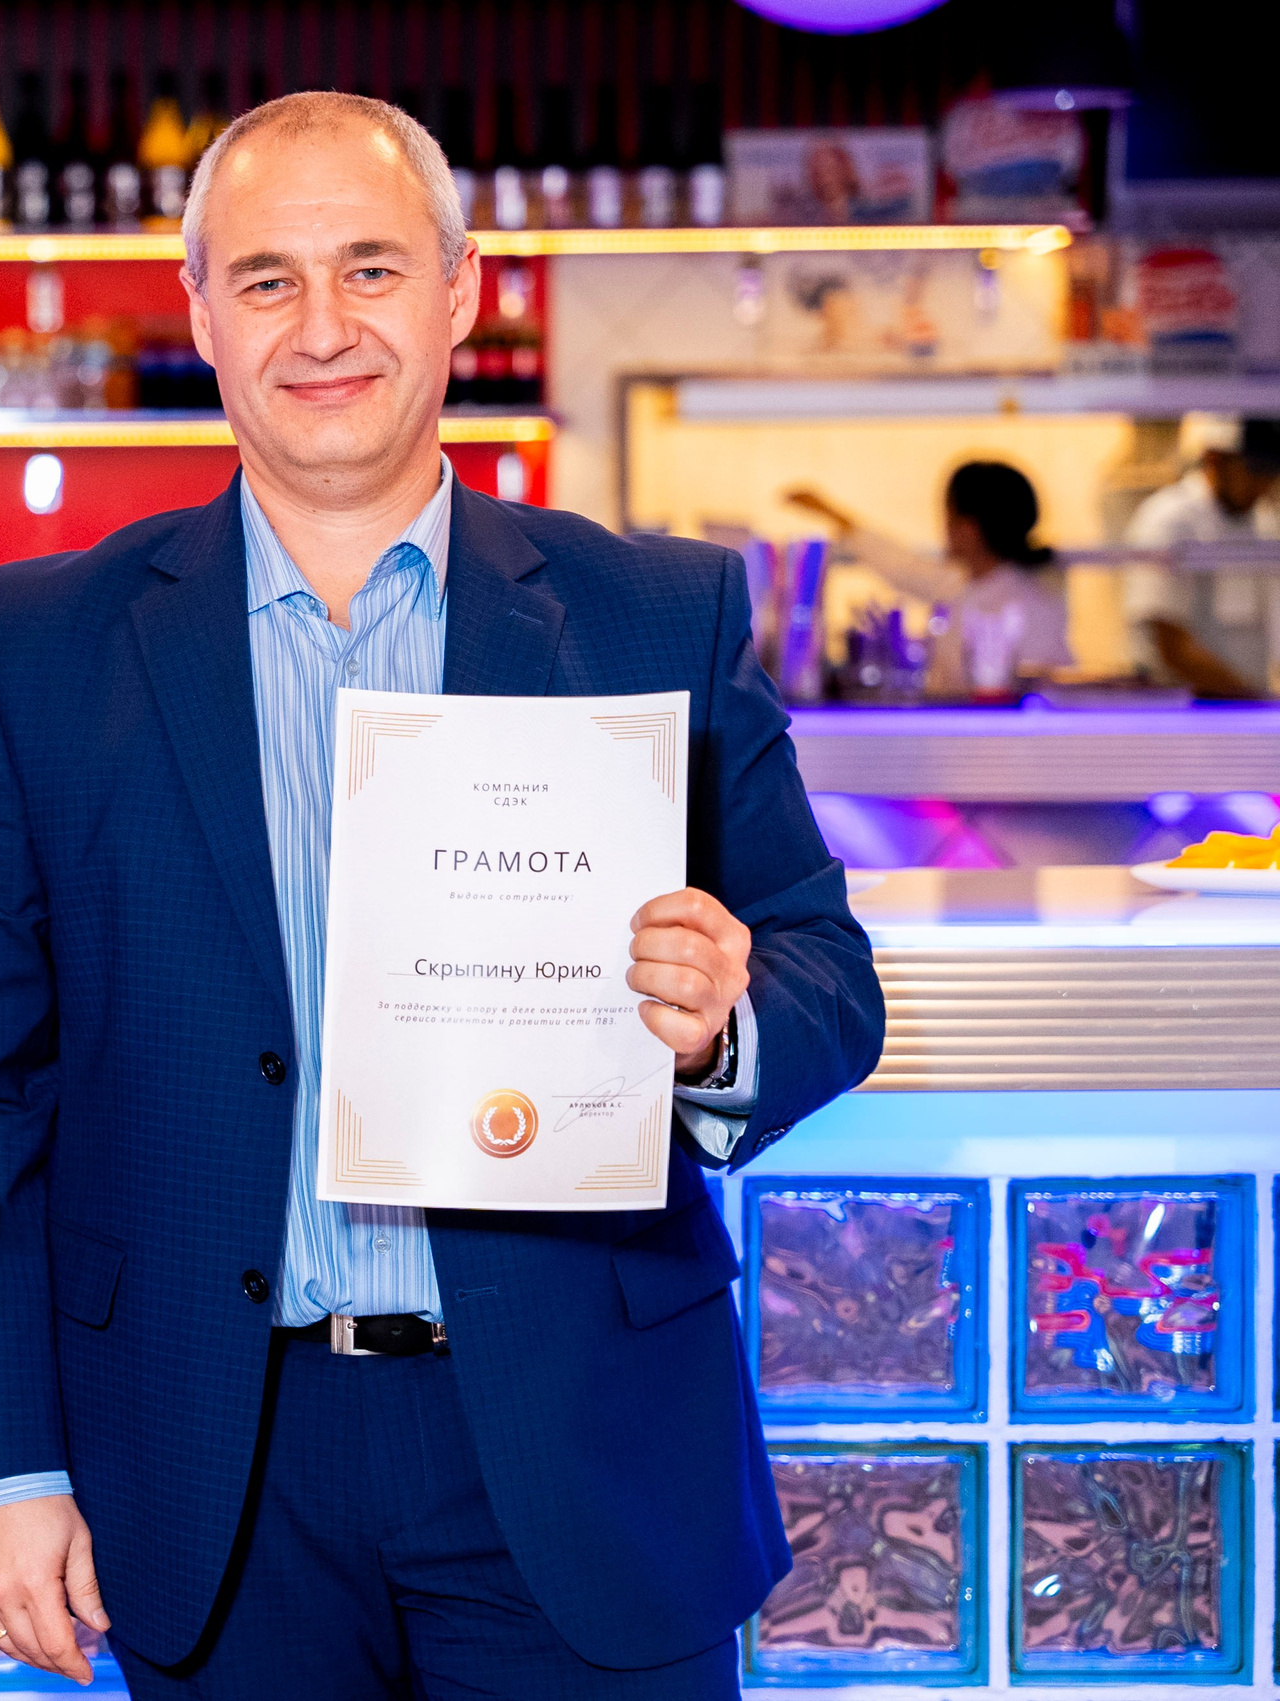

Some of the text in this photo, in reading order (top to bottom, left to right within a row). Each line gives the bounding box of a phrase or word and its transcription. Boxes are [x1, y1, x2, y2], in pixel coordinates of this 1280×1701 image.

[473, 783, 549, 793] КОМПАНИЯ
[493, 797, 528, 807] СДЭК
[433, 849, 592, 873] ГРАМОТА
[449, 892, 574, 903] Выдана сотруднику:
[414, 958, 602, 983] Скрыпину Юрию
[378, 1001, 390, 1009] За
[394, 1002, 452, 1013] поддержку
[592, 1007, 634, 1015] лучшего
[394, 1015, 437, 1023] сервиса
[509, 1019, 561, 1027] развитии
[595, 1017, 617, 1025] ПВЗ.
